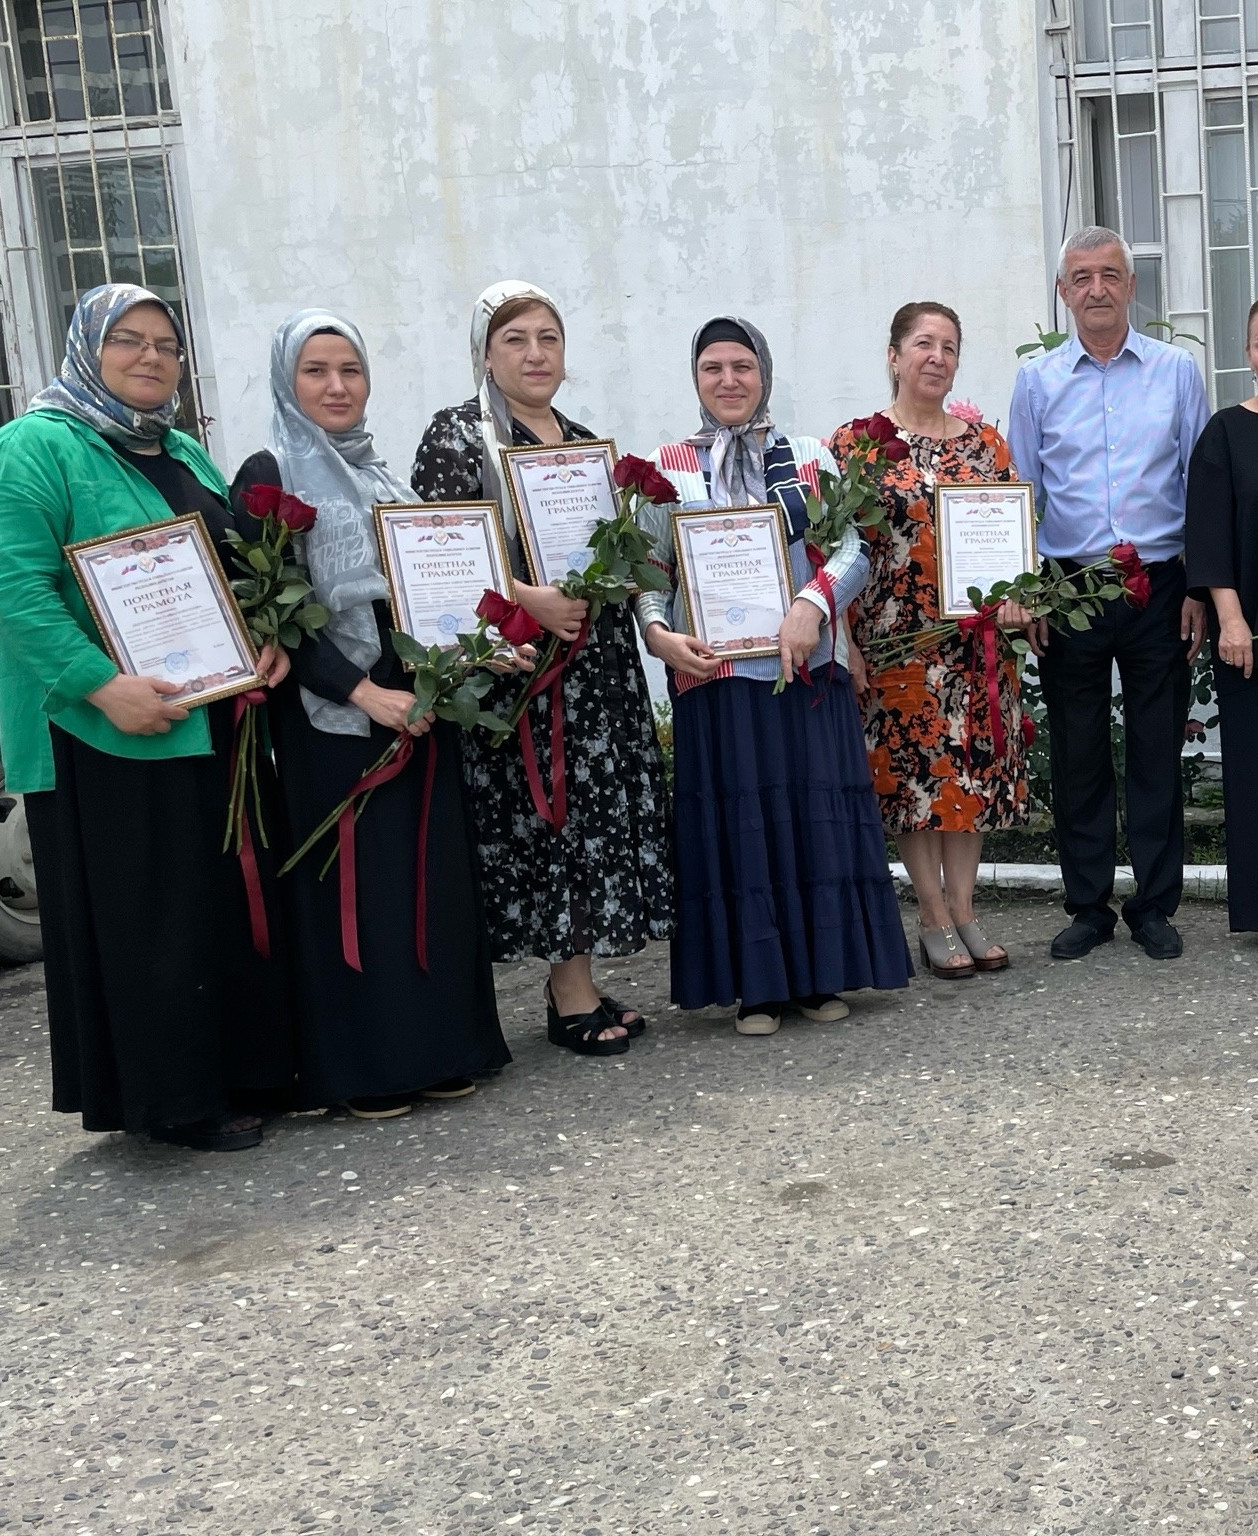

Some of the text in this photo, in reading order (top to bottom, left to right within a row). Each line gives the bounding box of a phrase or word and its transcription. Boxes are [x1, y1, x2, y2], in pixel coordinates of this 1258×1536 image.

[540, 495, 598, 507] ПОЧЕТНАЯ
[547, 503, 597, 515] ГРАМОТА
[413, 560, 476, 570] ПОЧЕТНАЯ
[705, 559, 762, 571] ПОЧЕТНАЯ
[420, 569, 474, 578] ГРАМОТА
[712, 568, 761, 578] ГРАМОТА
[122, 581, 192, 607] ПОЧЕТНАЯ
[133, 592, 192, 614] ГРАМОТА
